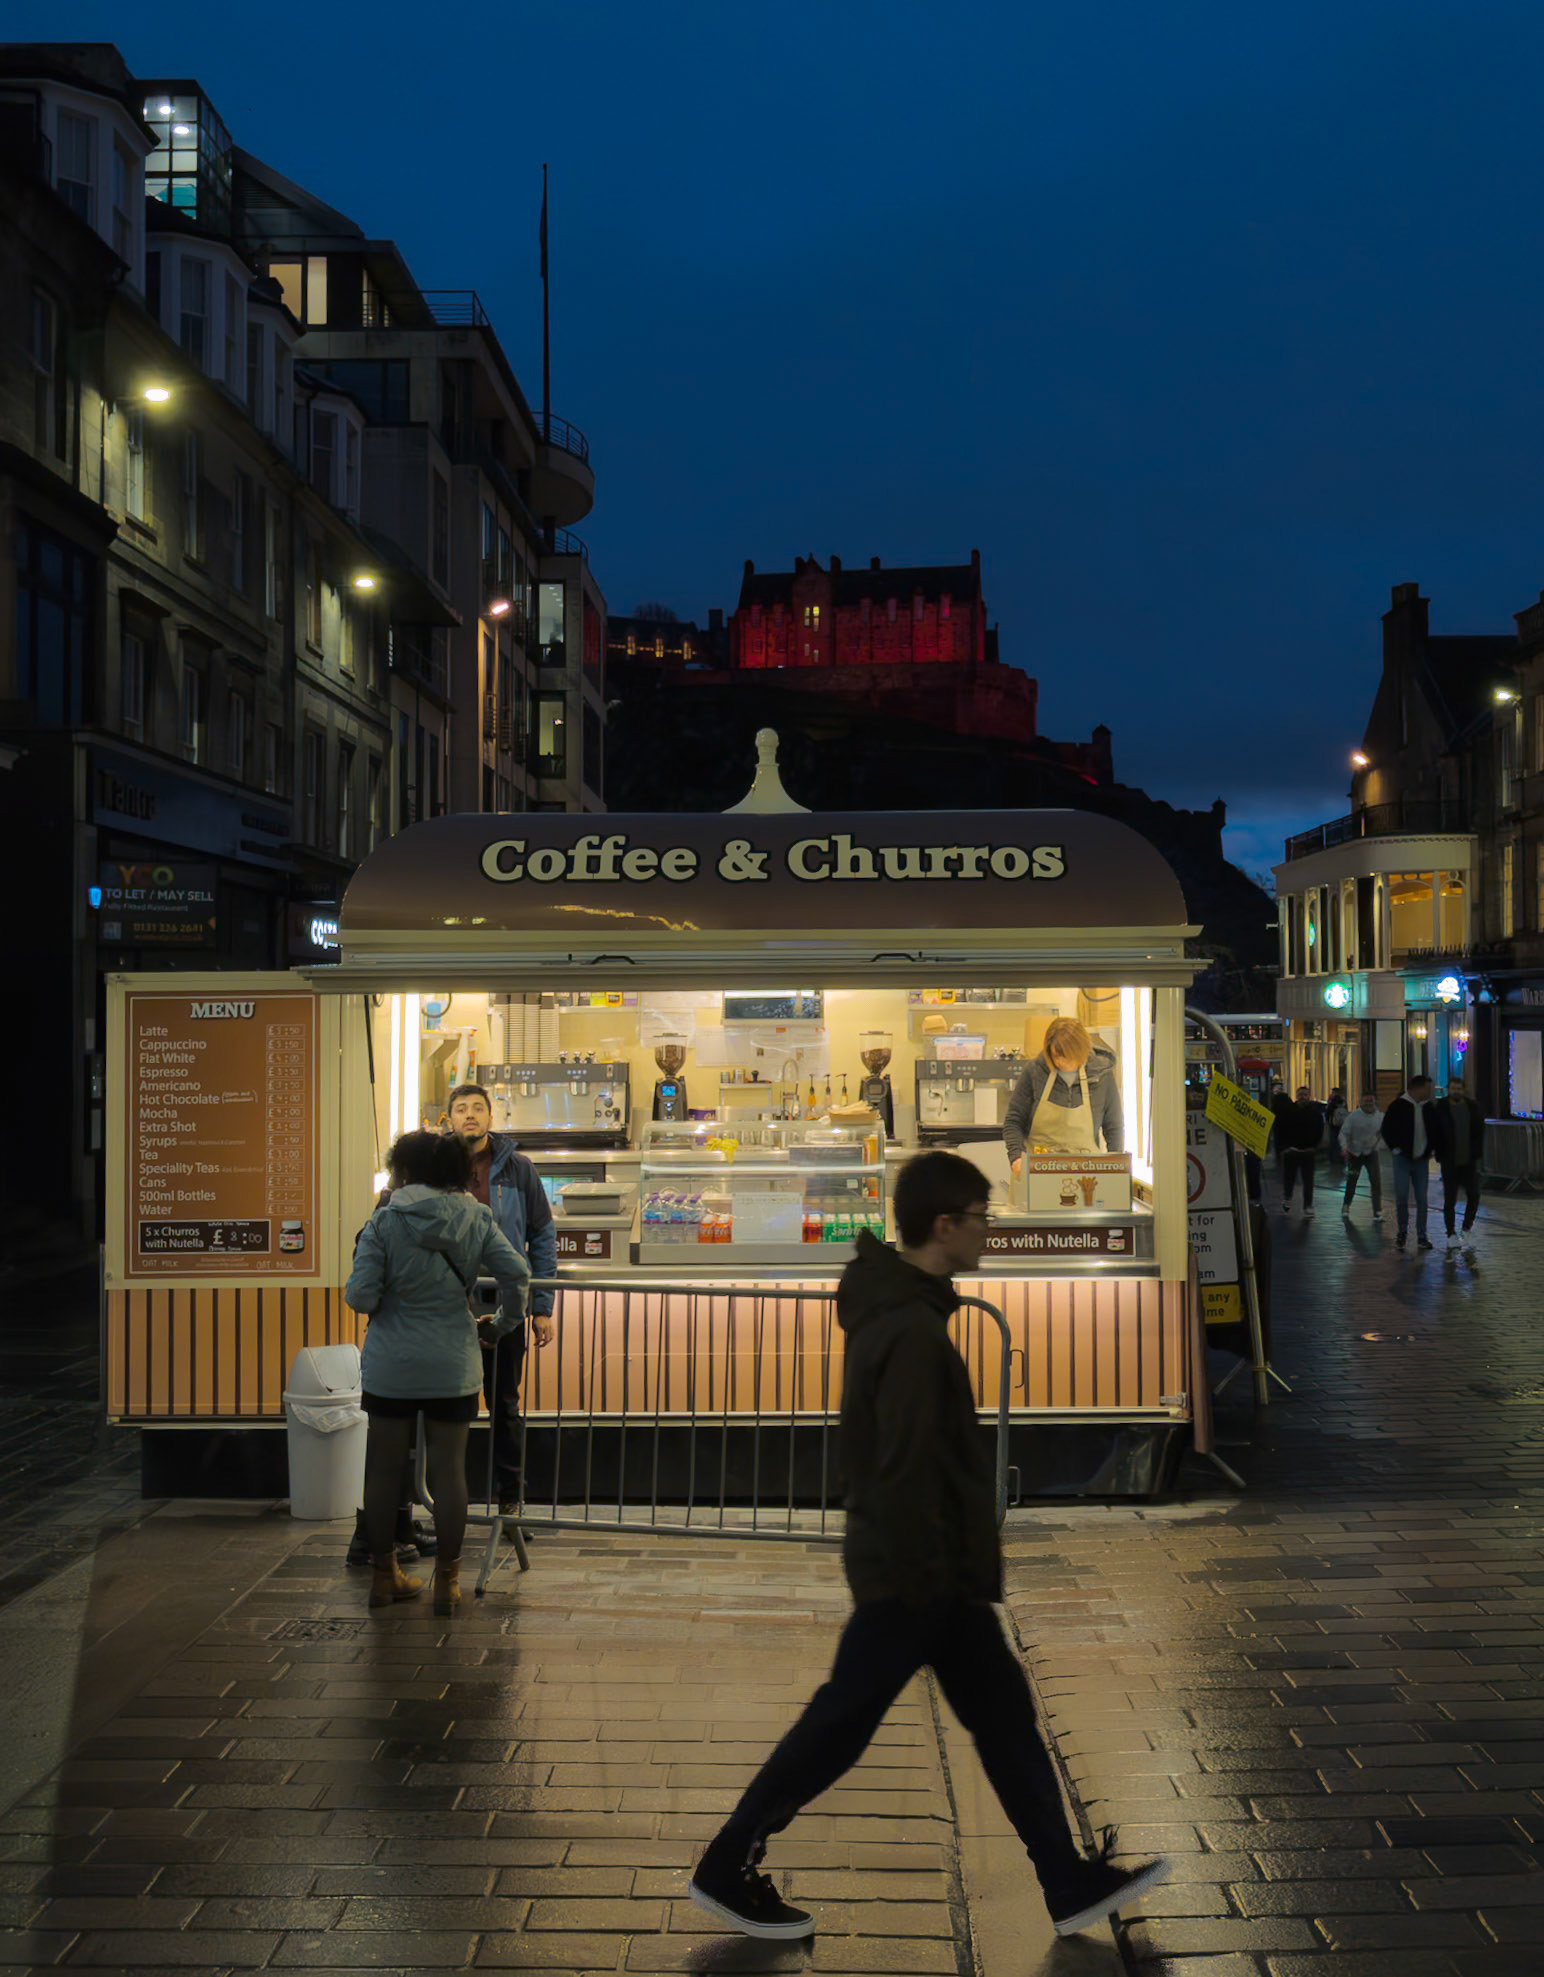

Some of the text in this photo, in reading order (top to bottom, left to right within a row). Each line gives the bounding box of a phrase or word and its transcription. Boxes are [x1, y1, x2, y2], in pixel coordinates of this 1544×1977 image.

[481, 834, 1067, 882] Coffee & Churros
[105, 888, 122, 899] TO
[125, 889, 146, 899] LET
[158, 890, 186, 901] MAY
[187, 891, 214, 902] SELL
[190, 1002, 255, 1019] MENU
[139, 1025, 168, 1037] Latte
[139, 1039, 207, 1052] Cappuccino
[139, 1053, 196, 1064] Flat White
[139, 1067, 188, 1079] Espresso
[139, 1080, 201, 1091] Americano
[139, 1094, 160, 1105] Hot
[162, 1094, 220, 1105] Chocolate
[1214, 1083, 1229, 1099] NO
[1230, 1095, 1267, 1128] PARKING
[139, 1108, 177, 1119] Mocha
[139, 1121, 197, 1133] Extra Shot
[139, 1135, 177, 1148] Syrups
[139, 1149, 158, 1160] Tea
[139, 1162, 194, 1176] Speciality
[195, 1162, 220, 1173] Teas
[1034, 1160, 1125, 1172] Coffee & Churros
[139, 1177, 167, 1188] Cans
[139, 1190, 216, 1201] 500ml Bottles
[139, 1204, 172, 1215] Water
[1198, 1214, 1215, 1226] for
[145, 1227, 151, 1237] 5
[161, 1226, 200, 1237] Churros
[145, 1238, 167, 1249] with
[169, 1238, 204, 1249] Nutella
[555, 1236, 578, 1252] ella
[1011, 1234, 1044, 1249] with
[1047, 1233, 1100, 1249] Nutella
[1208, 1292, 1230, 1303] any
